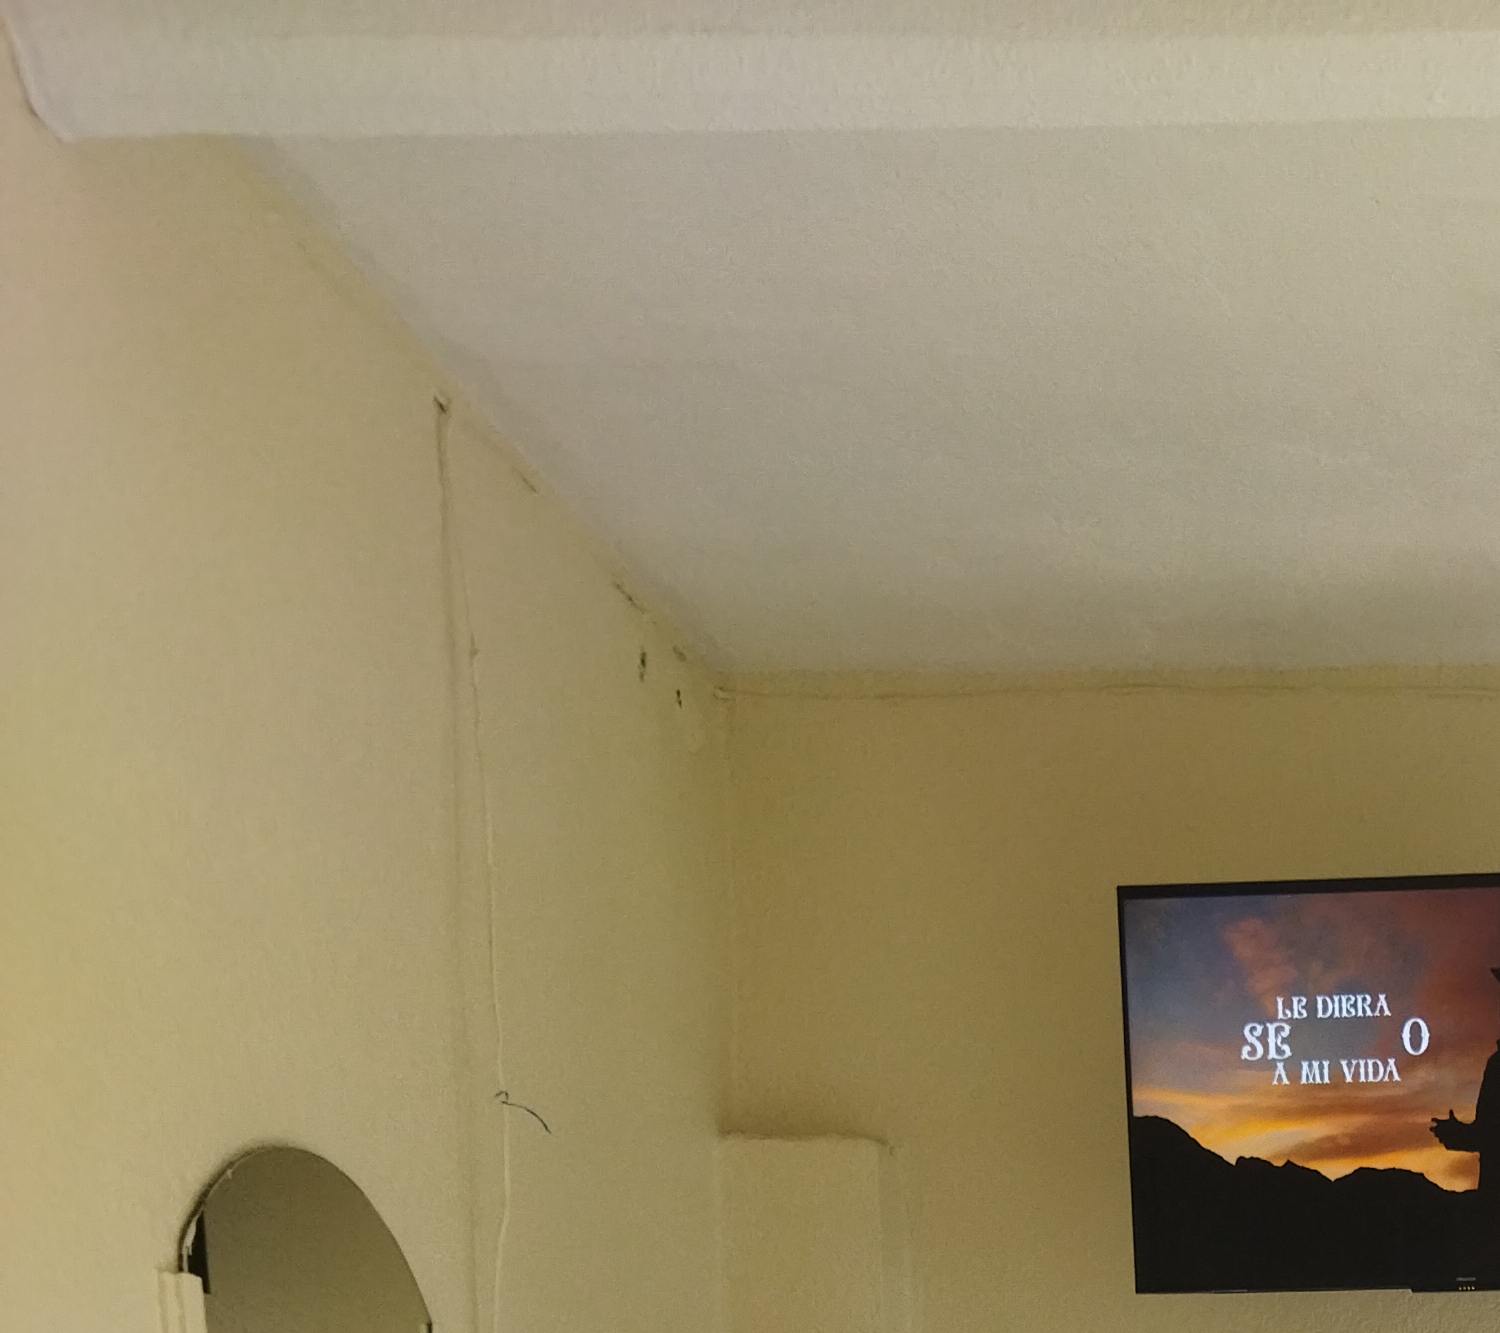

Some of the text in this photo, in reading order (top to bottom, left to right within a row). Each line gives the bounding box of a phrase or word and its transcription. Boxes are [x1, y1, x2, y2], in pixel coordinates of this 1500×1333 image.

[1276, 993, 1392, 1020] LE DIERA
[1240, 1017, 1430, 1061] SE O
[1272, 1058, 1401, 1085] A MI VIDA
